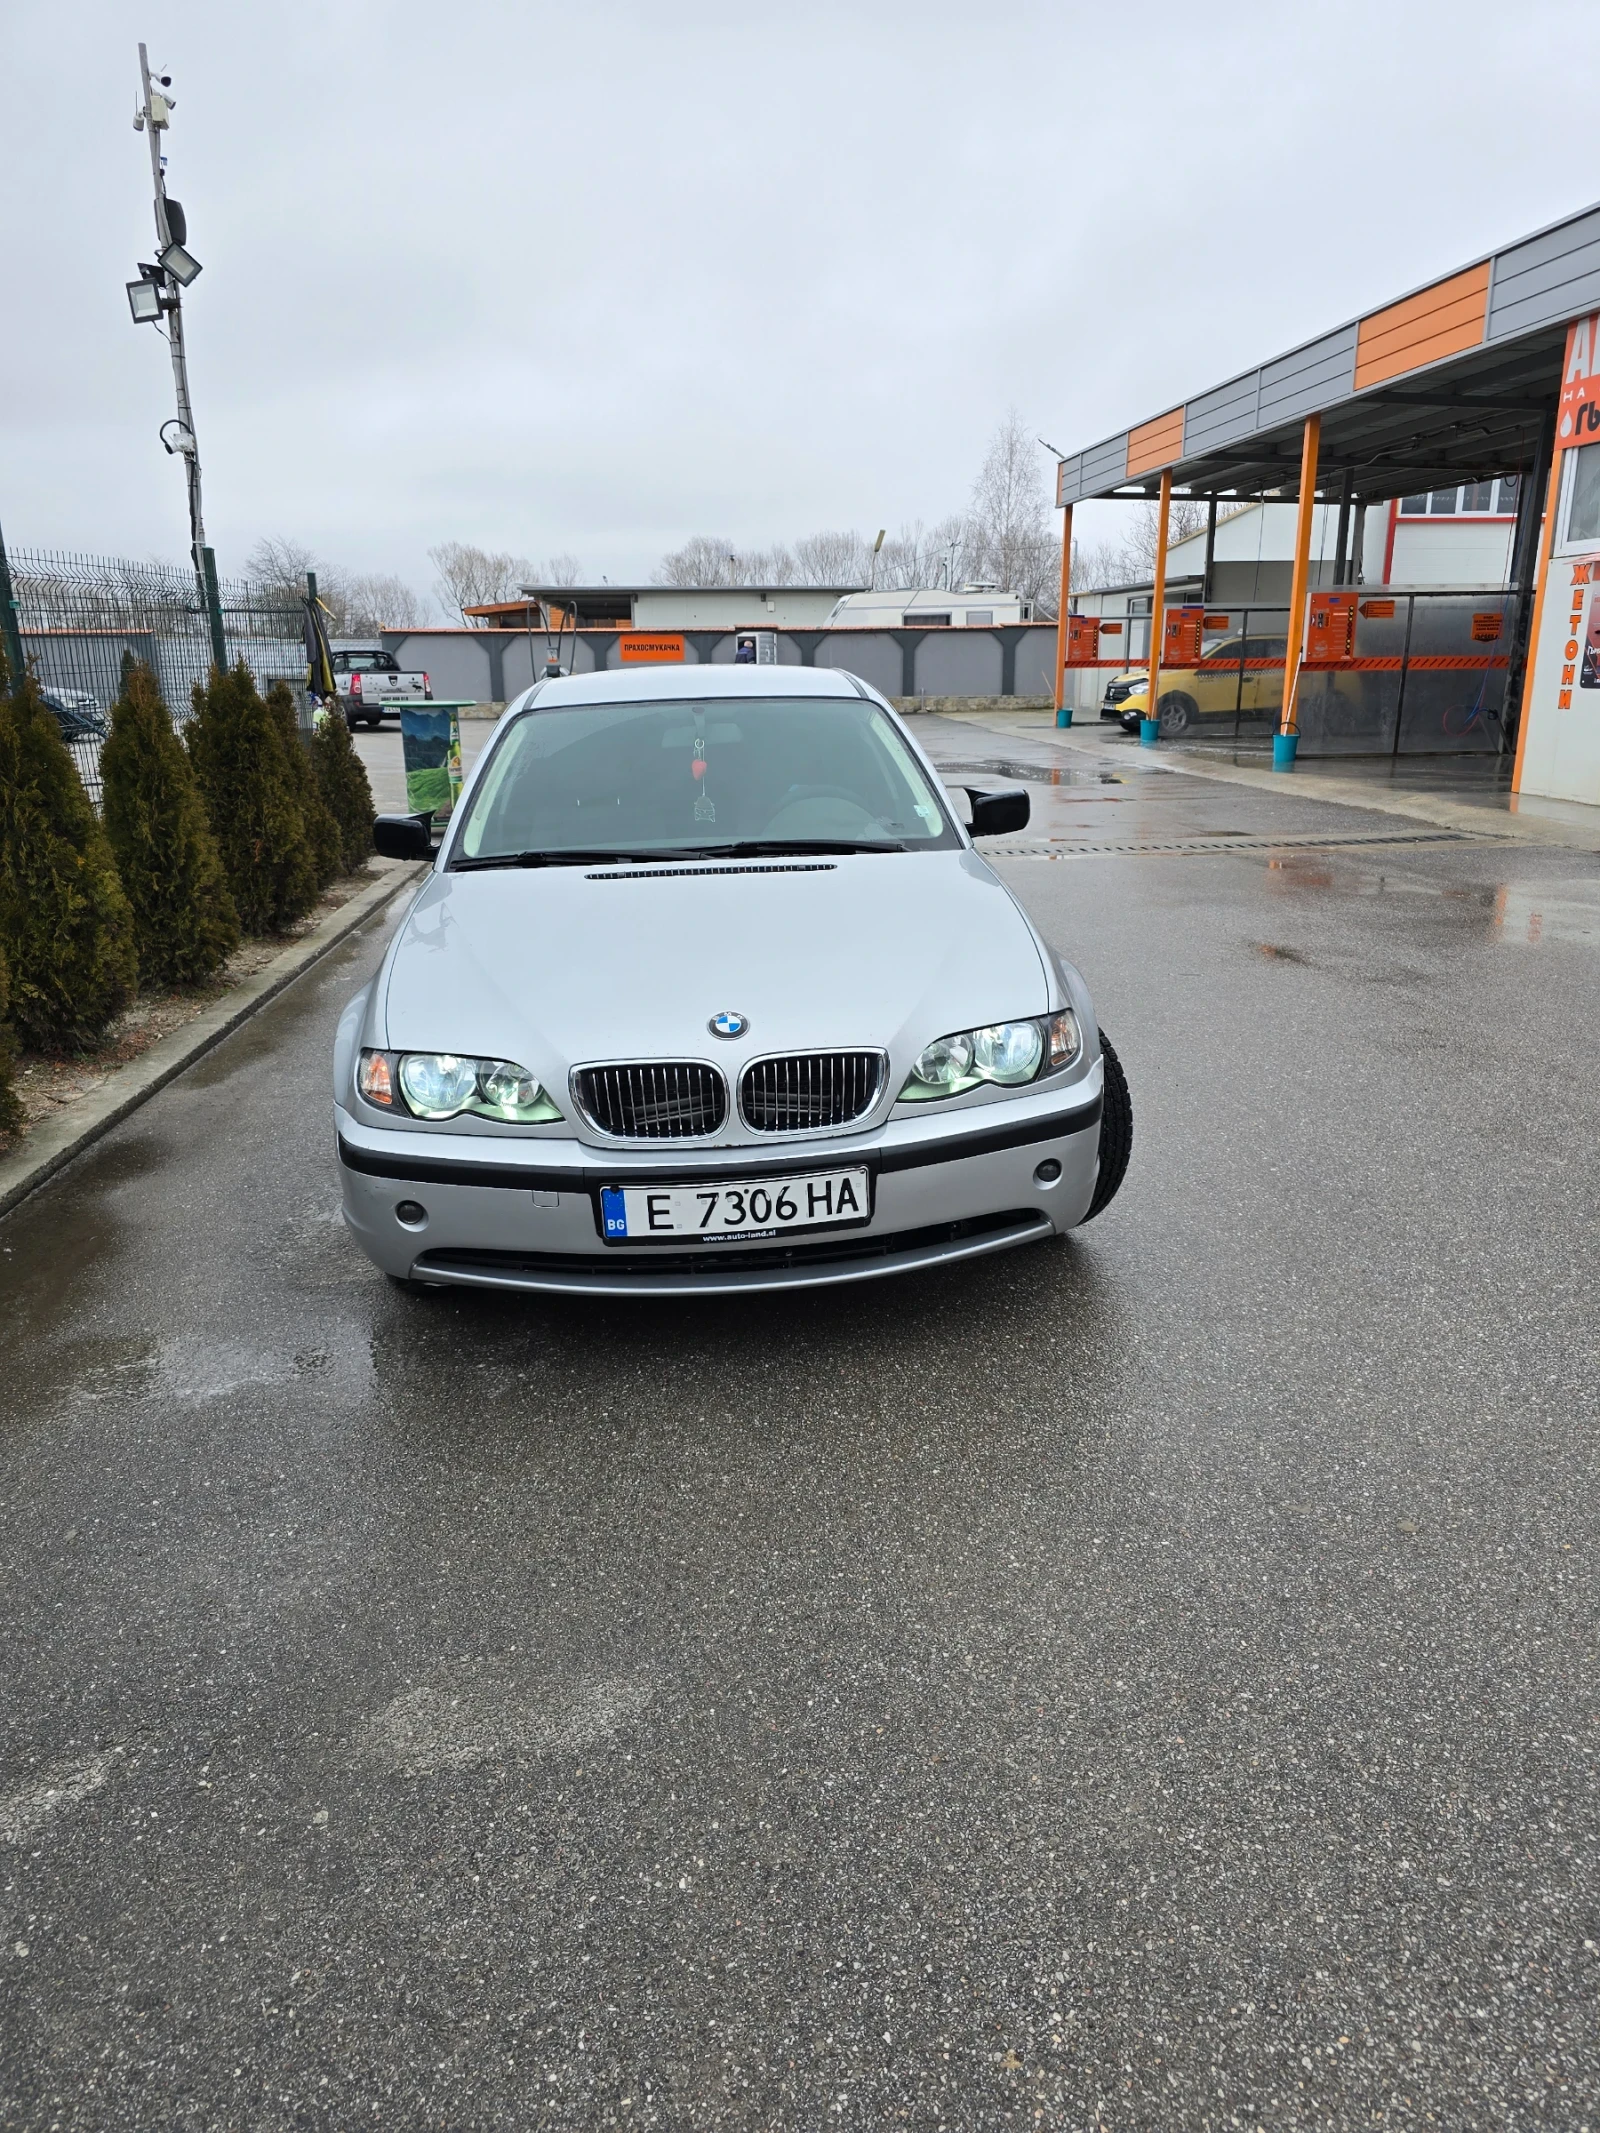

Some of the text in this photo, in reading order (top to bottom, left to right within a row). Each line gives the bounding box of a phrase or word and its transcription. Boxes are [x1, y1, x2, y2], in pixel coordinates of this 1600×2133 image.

[624, 644, 680, 652] ПРАХОСМУКАЧКА
[1558, 563, 1592, 709] ЖЕТОНИ
[647, 1177, 860, 1231] E 7306 HA
[607, 1219, 625, 1231] BG
